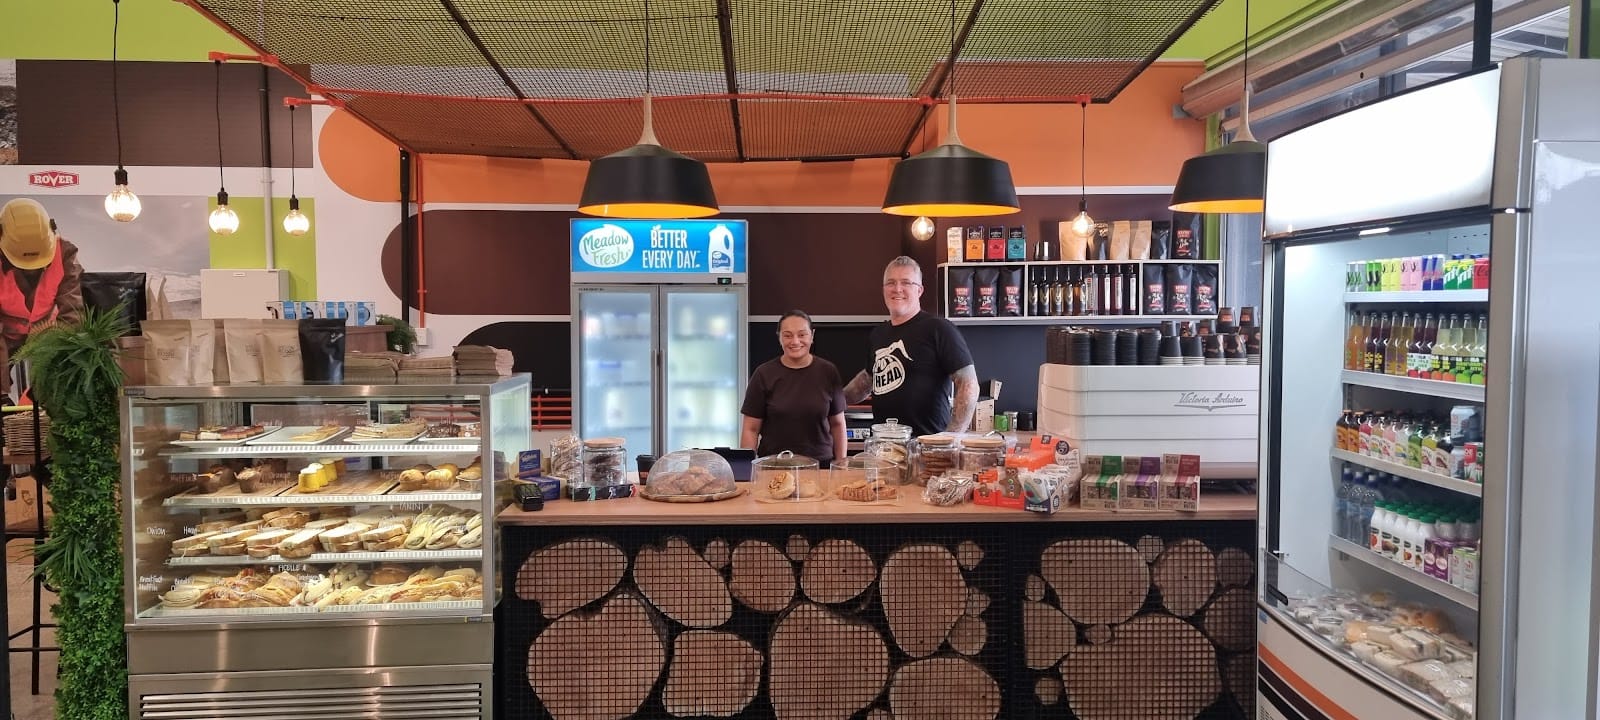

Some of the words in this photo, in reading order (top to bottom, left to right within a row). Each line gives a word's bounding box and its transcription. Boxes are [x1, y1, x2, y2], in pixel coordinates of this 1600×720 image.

[34, 173, 74, 187] ROVER
[583, 229, 629, 255] Meadow
[650, 229, 688, 248] BETTER
[592, 246, 629, 266] Fresh
[642, 250, 673, 269] EVERY
[875, 367, 902, 388] HEAD
[1179, 392, 1210, 404] Victoria
